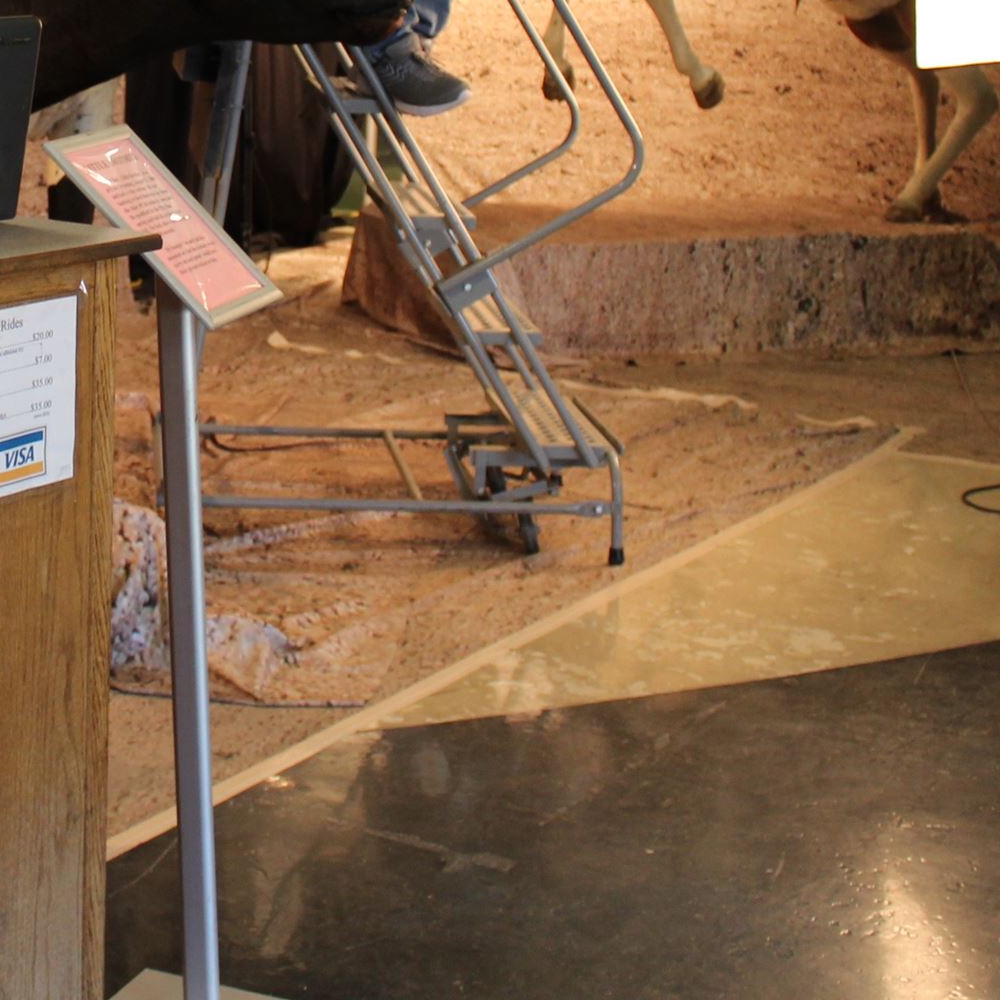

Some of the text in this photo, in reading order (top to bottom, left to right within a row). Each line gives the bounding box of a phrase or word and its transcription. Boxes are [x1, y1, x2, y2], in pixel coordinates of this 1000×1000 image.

[0, 318, 24, 332] Rides
[32, 330, 54, 342] $20.00
[34, 354, 53, 366] $7.00
[5, 445, 34, 470] VISA
